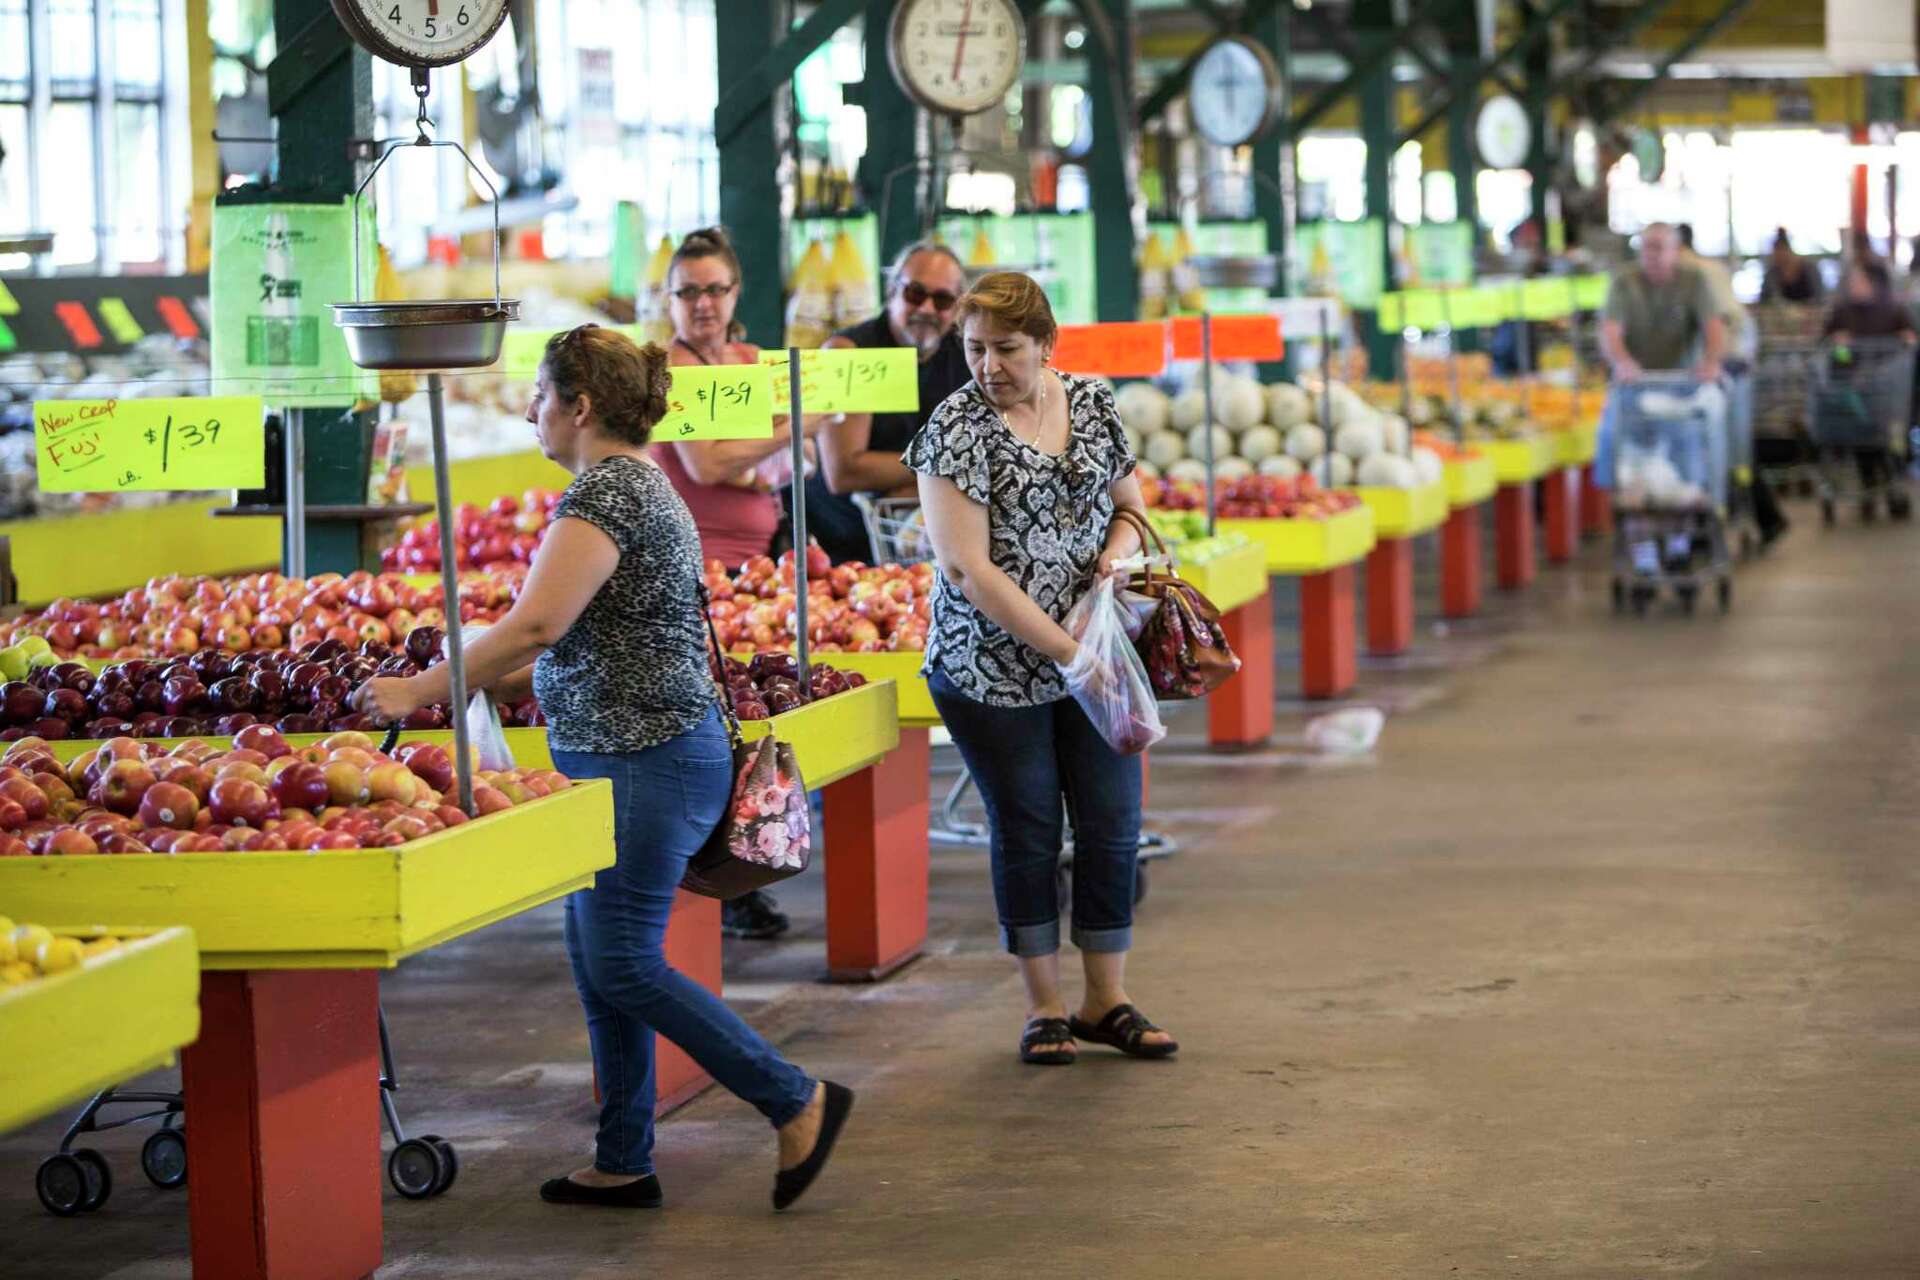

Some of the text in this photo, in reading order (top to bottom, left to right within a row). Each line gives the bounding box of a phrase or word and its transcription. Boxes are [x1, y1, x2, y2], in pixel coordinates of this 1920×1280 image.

[388, 4, 402, 25] 4
[457, 4, 470, 26] 6
[425, 17, 437, 38] 5
[40, 412, 74, 436] New
[144, 414, 221, 473] $1.39
